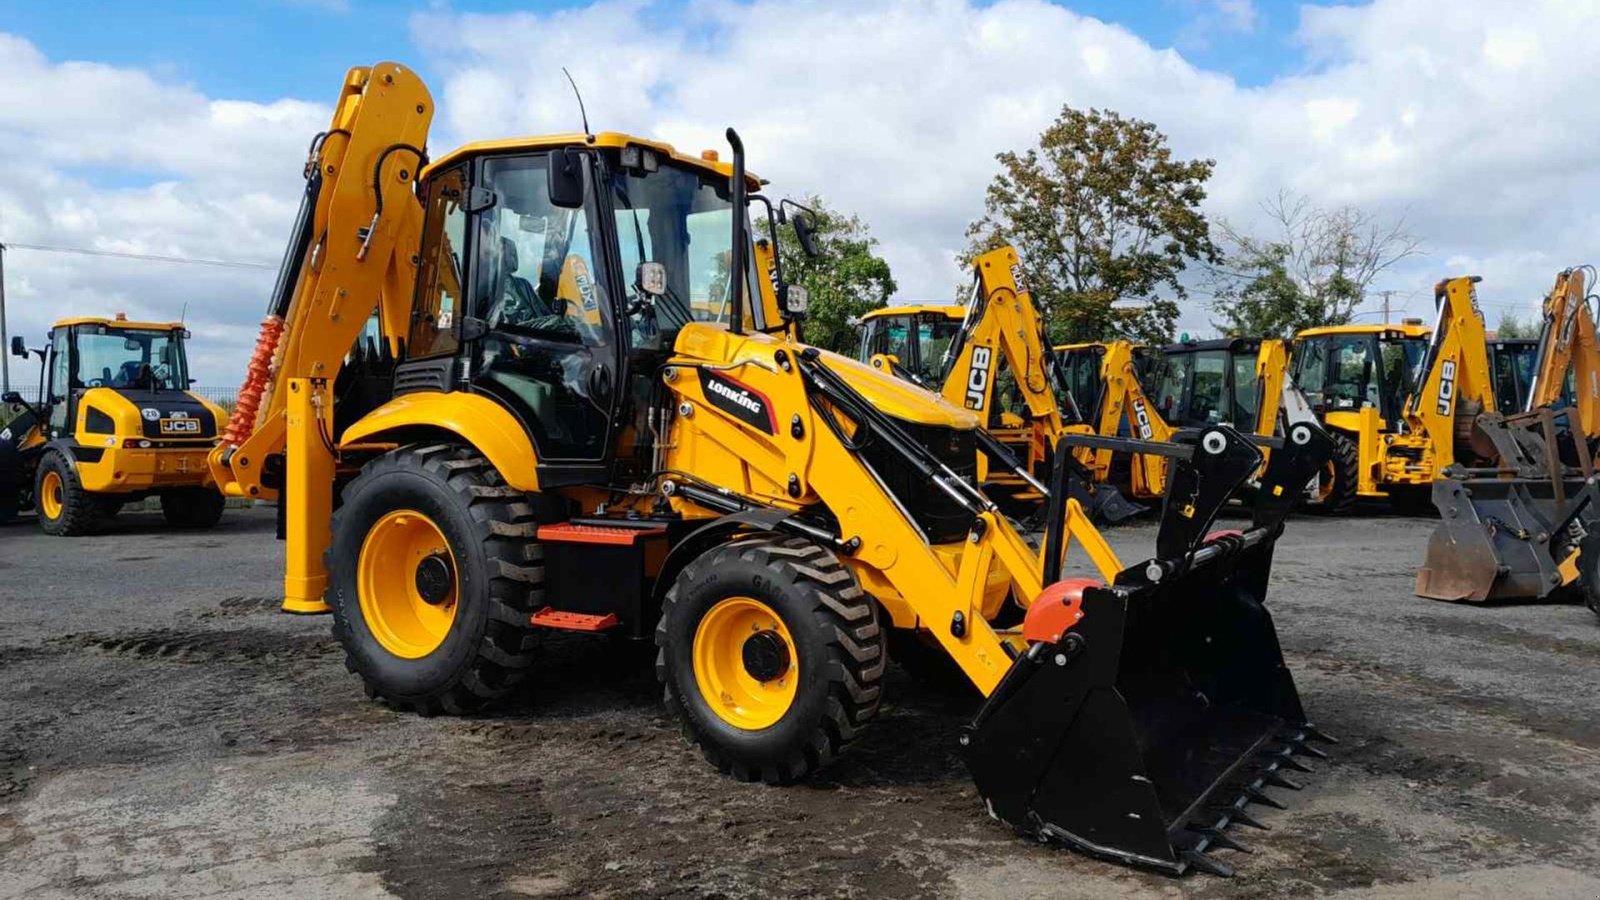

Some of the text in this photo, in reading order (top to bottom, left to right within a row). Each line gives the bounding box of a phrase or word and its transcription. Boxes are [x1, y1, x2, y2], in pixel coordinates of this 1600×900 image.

[966, 347, 991, 410] JCB
[1437, 361, 1456, 416] JCB
[163, 420, 198, 431] JCB
[1133, 400, 1152, 440] JCB
